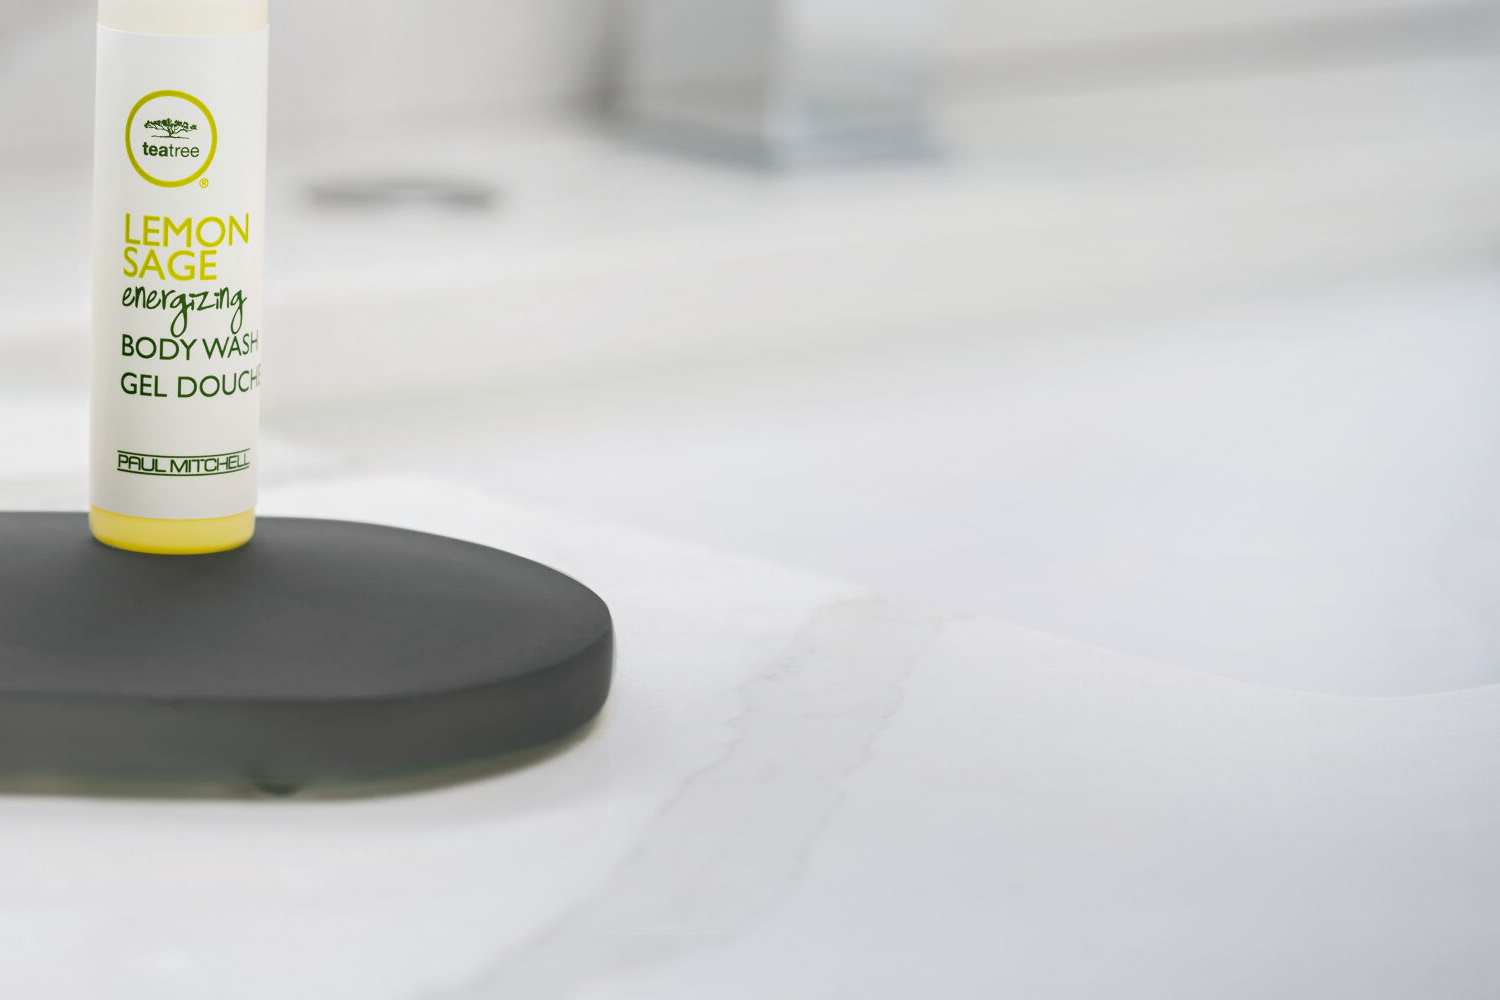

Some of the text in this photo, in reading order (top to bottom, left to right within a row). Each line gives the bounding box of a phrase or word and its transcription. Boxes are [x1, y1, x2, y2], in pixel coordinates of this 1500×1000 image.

[142, 142, 199, 157] teatree
[125, 213, 249, 247] LEMON
[123, 247, 217, 281] SAGE
[122, 286, 247, 338] energizing
[122, 328, 258, 360] BODY WASH
[121, 372, 167, 396] GEL
[118, 453, 250, 473] PAUL MITCHELL
